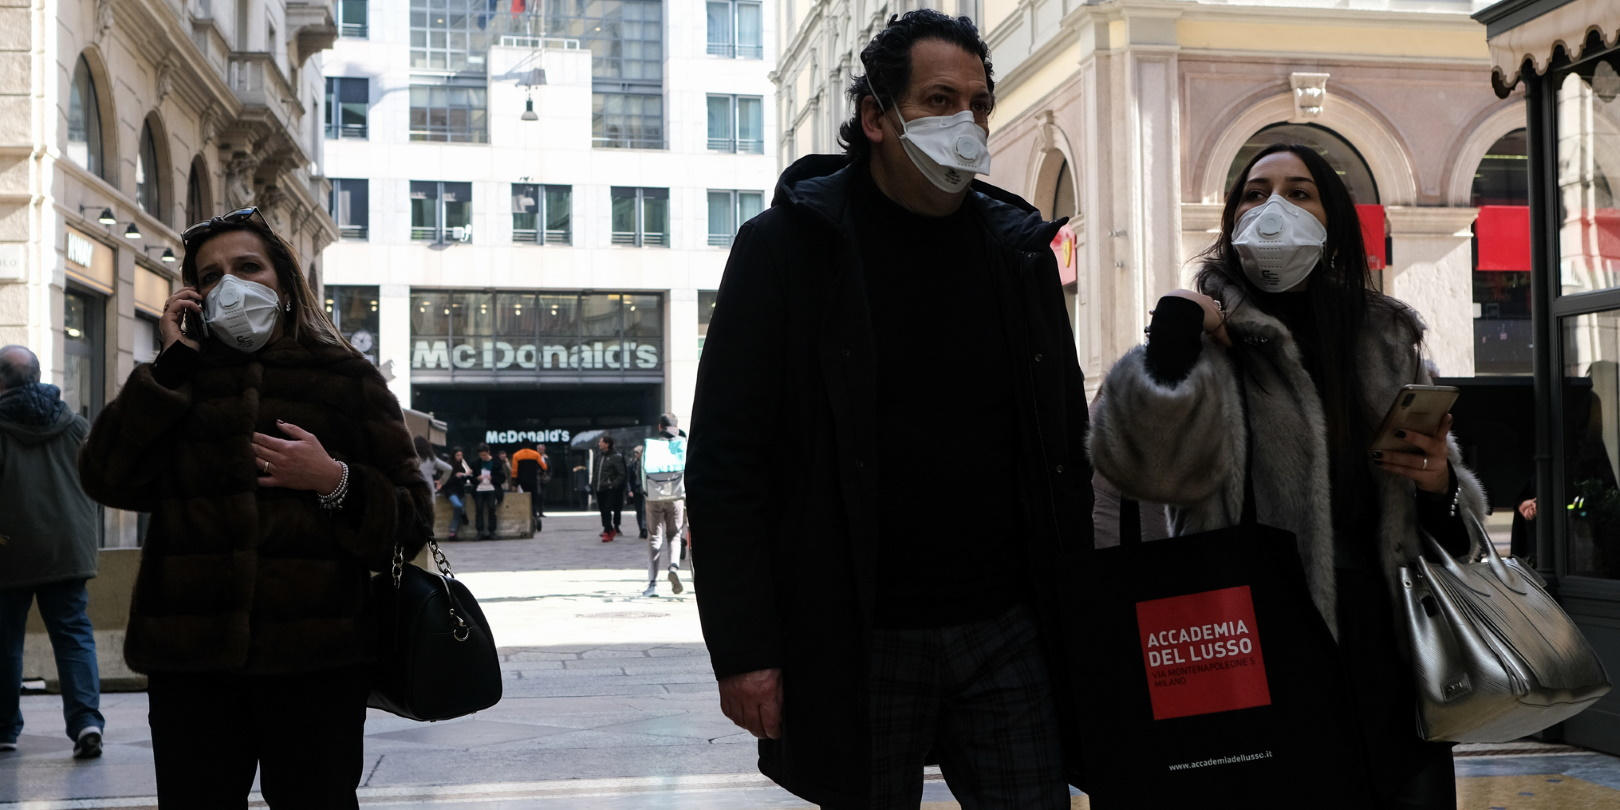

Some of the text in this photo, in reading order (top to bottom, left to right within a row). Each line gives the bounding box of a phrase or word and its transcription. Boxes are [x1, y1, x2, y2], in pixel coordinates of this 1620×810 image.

[412, 340, 659, 370] McDonald's
[1147, 619, 1249, 648] ACCADEMIA
[1148, 637, 1253, 667] DEL LUSSO
[1152, 669, 1167, 679] VIA
[1167, 659, 1248, 677] MONTENAPOLEONE
[1154, 677, 1187, 688] MILANO
[1168, 750, 1274, 772] www.accademiadellusso.it
